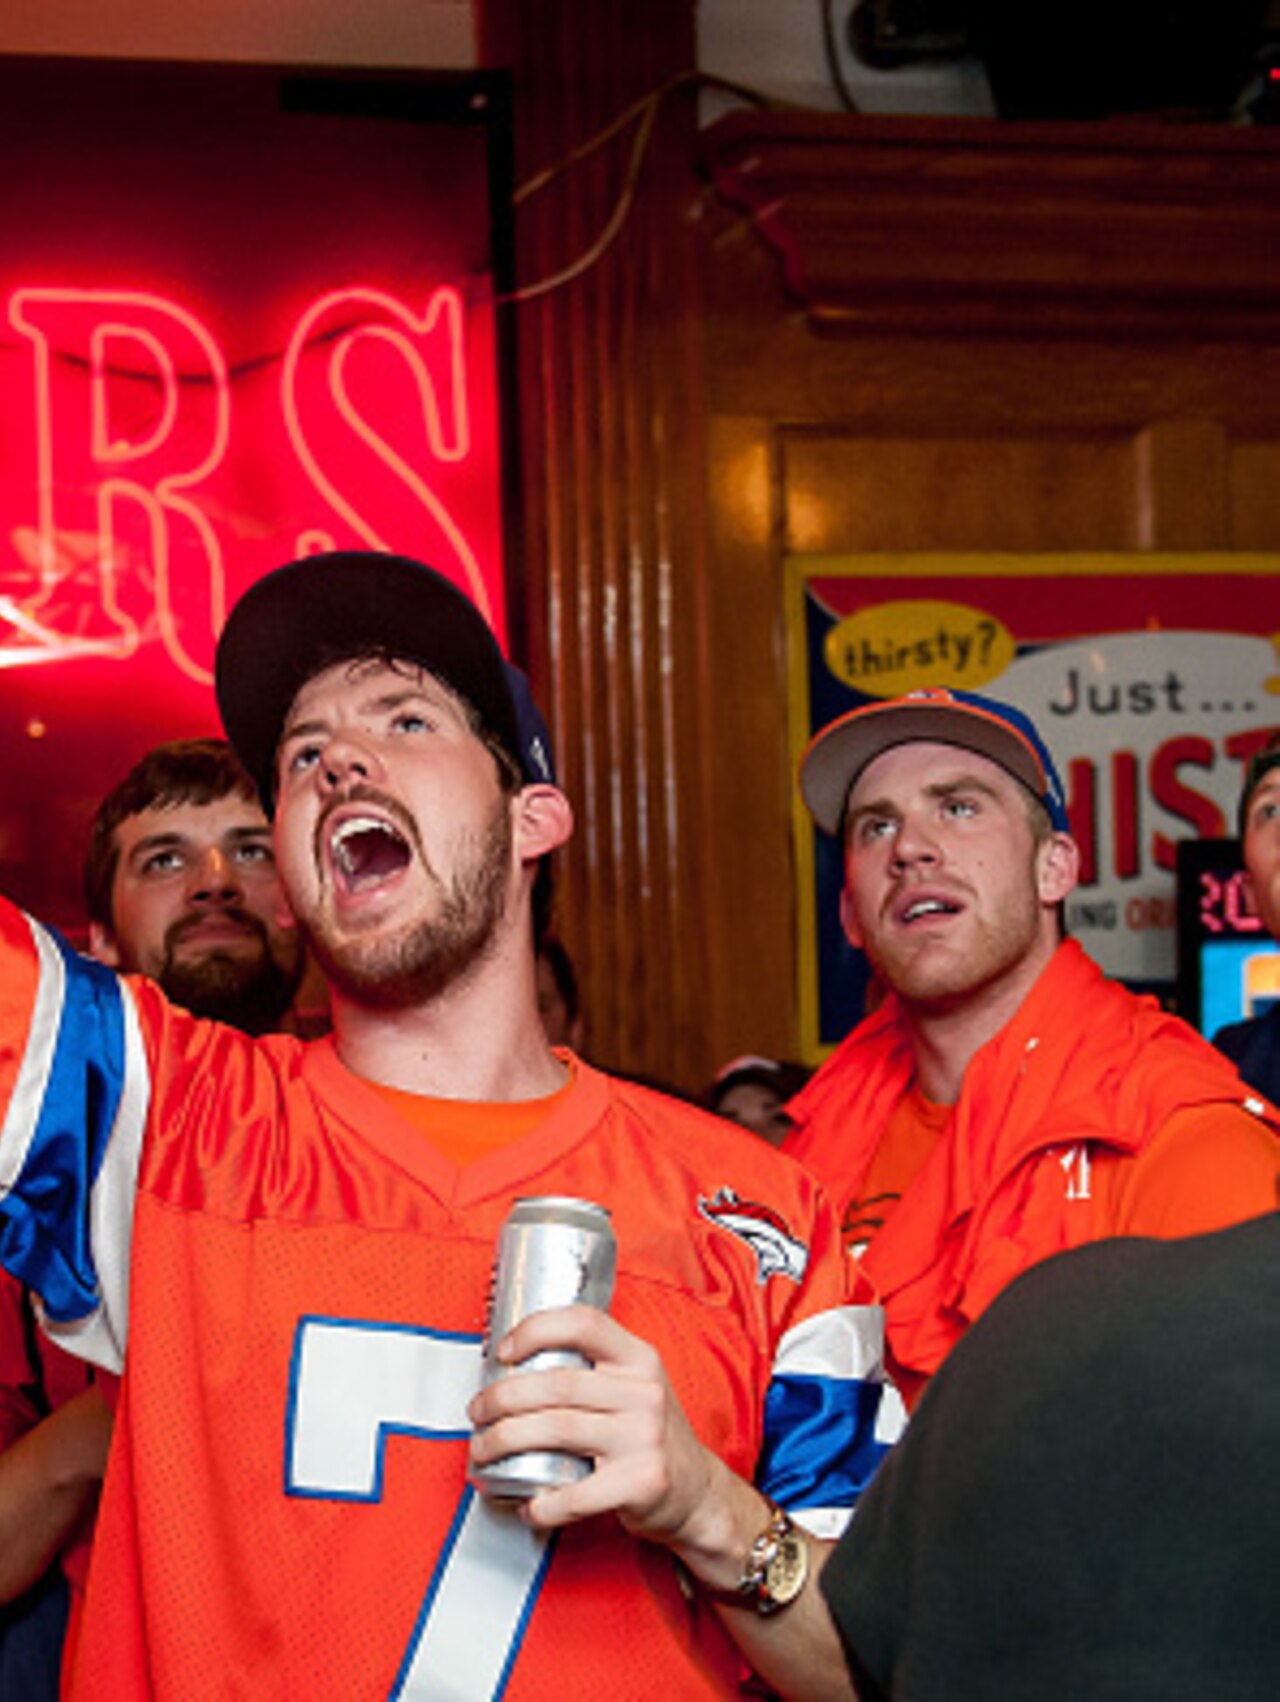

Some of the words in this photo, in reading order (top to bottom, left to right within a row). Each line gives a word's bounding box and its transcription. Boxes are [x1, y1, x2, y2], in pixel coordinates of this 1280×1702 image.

[844, 620, 998, 678] thirsty?
[1049, 667, 1256, 716] Just...
[1070, 901, 1118, 932] ING
[284, 1314, 560, 1702] 7
